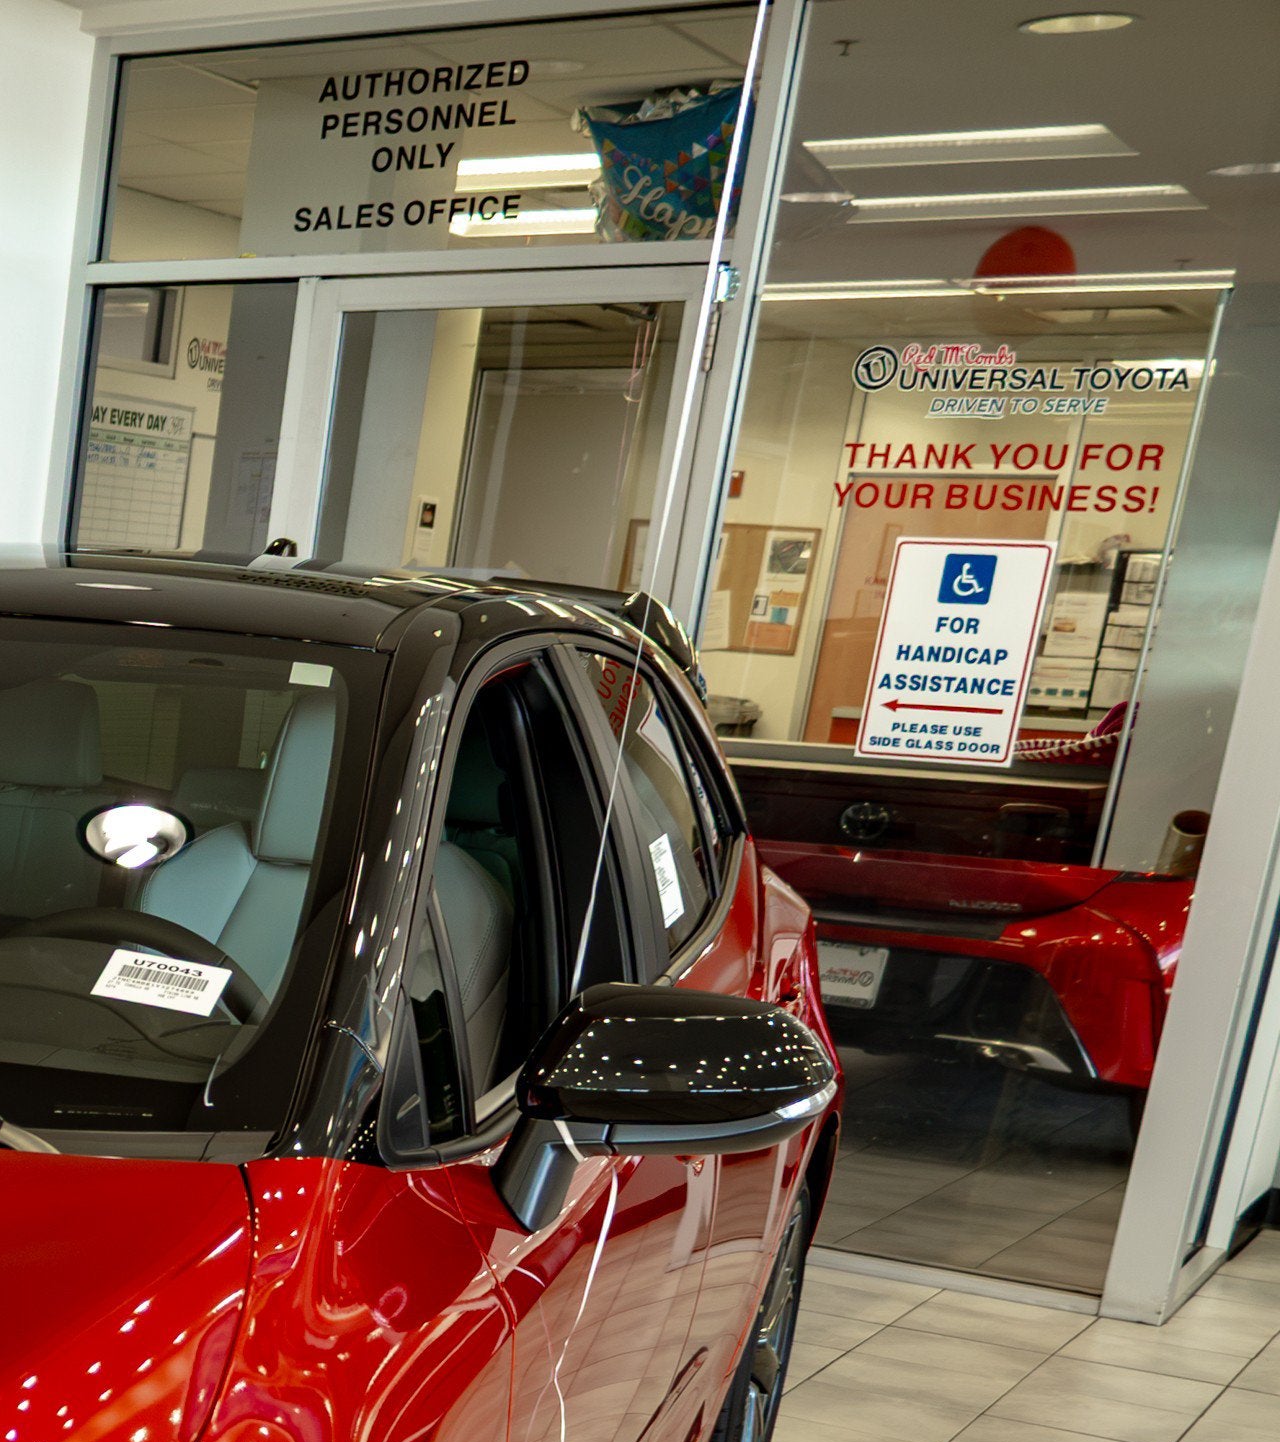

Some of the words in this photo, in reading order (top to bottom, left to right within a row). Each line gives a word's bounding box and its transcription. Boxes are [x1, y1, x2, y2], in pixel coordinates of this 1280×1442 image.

[318, 60, 529, 103] AUTHORIZED
[320, 100, 517, 140] PERSONNEL
[371, 142, 455, 173] ONLY
[294, 202, 395, 232] SALES
[403, 195, 522, 226] OFFICE
[902, 343, 936, 367] Red
[899, 367, 1064, 391] UNIVERSAL
[1073, 367, 1190, 391] TOYOTA
[930, 398, 1005, 414] DRIVEN
[1010, 398, 1038, 414] TO
[1043, 398, 1107, 414] SERVE
[92, 405, 108, 424] AY
[109, 407, 145, 428] EVERY
[146, 413, 168, 432] DAY
[845, 443, 977, 469] THANK
[990, 443, 1069, 470] YOU
[1079, 443, 1165, 471] FOR
[834, 482, 935, 509] YOUR
[945, 484, 1159, 513] BUSINESS!
[935, 616, 980, 635] FOR
[896, 644, 1008, 666] HANDICAP
[878, 673, 1016, 696] ASSISTANCE
[891, 722, 949, 735] PLEASE
[953, 725, 983, 737] USE
[869, 736, 901, 748] SIDE
[905, 738, 953, 751] GLASS
[957, 741, 1001, 754] DOOR
[133, 958, 203, 977] U70043
